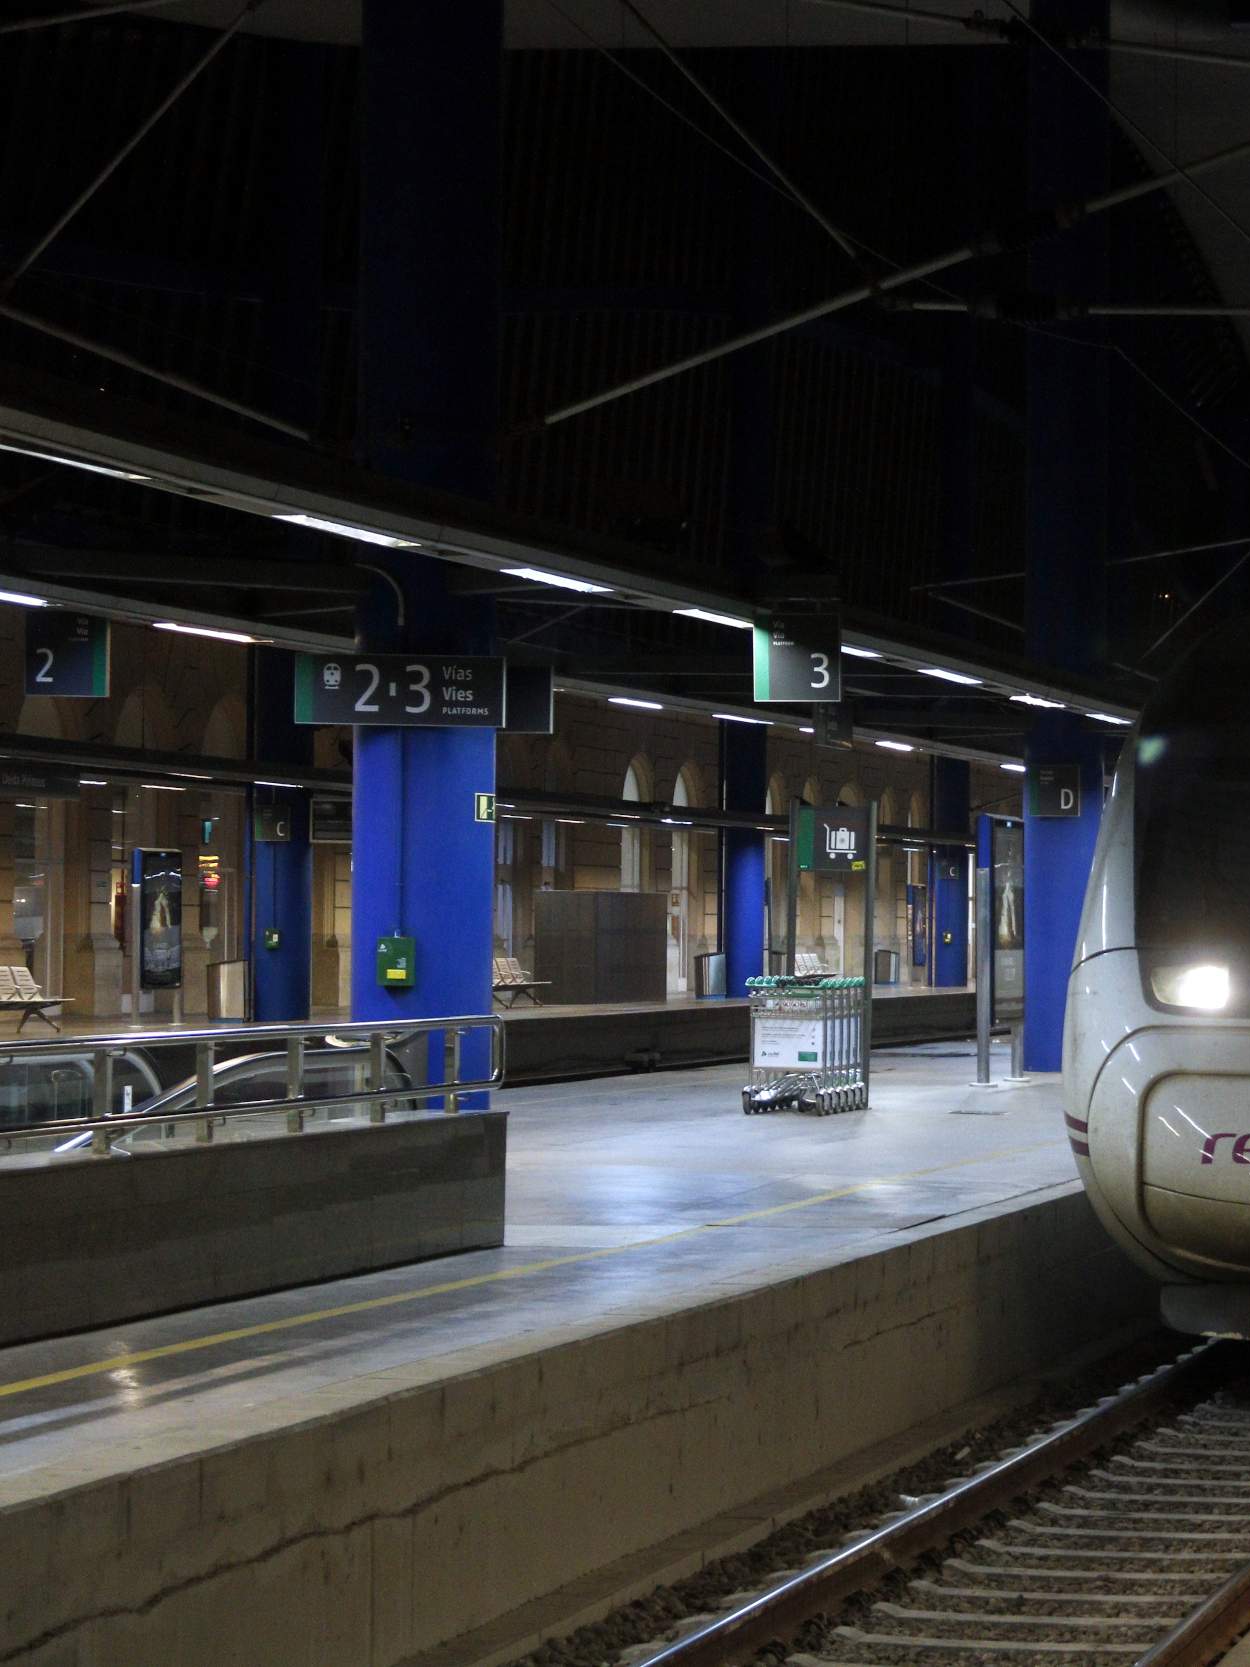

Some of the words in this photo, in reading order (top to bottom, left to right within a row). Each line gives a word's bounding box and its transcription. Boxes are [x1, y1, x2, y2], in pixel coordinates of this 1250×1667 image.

[35, 647, 54, 682] 2
[810, 652, 830, 688] 3
[442, 686, 473, 701] Vies
[442, 707, 489, 715] PLATFORMS
[1060, 788, 1074, 809] D
[276, 821, 285, 836] C
